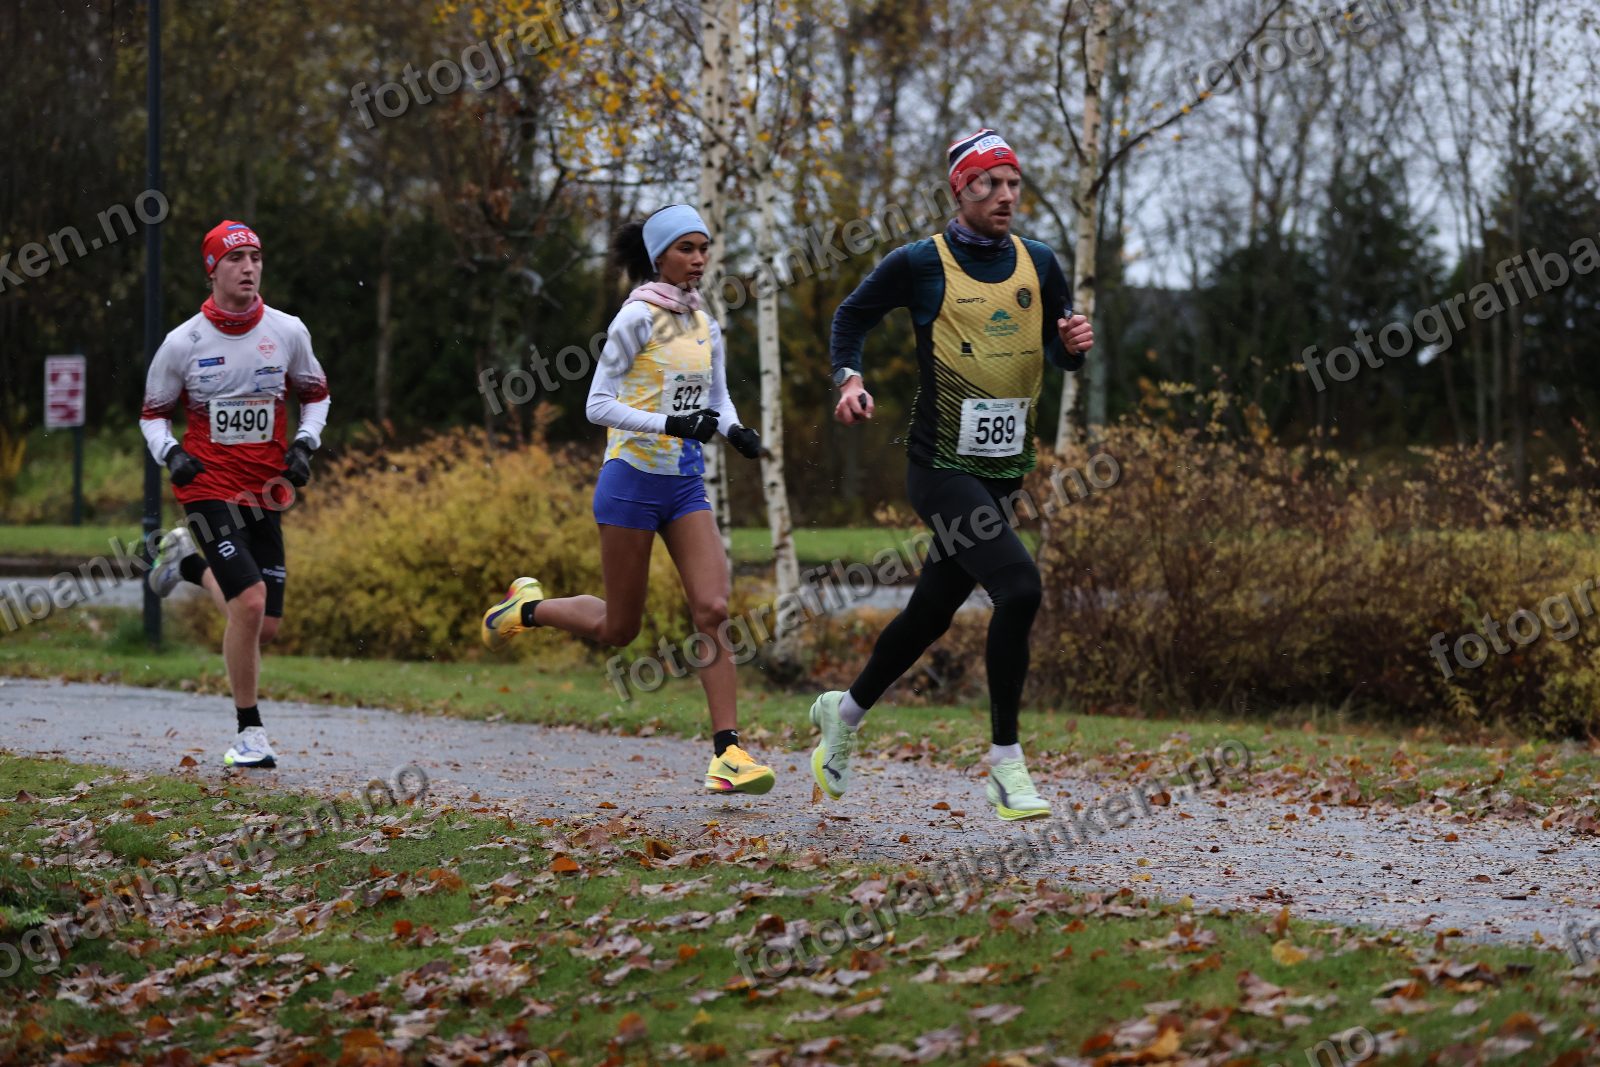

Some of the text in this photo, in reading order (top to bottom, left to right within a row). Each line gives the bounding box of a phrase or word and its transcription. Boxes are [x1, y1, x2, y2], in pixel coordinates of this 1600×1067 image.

[222, 231, 247, 248] NES
[672, 385, 702, 411] 522
[216, 409, 268, 433] 9490
[975, 415, 1016, 445] 589
